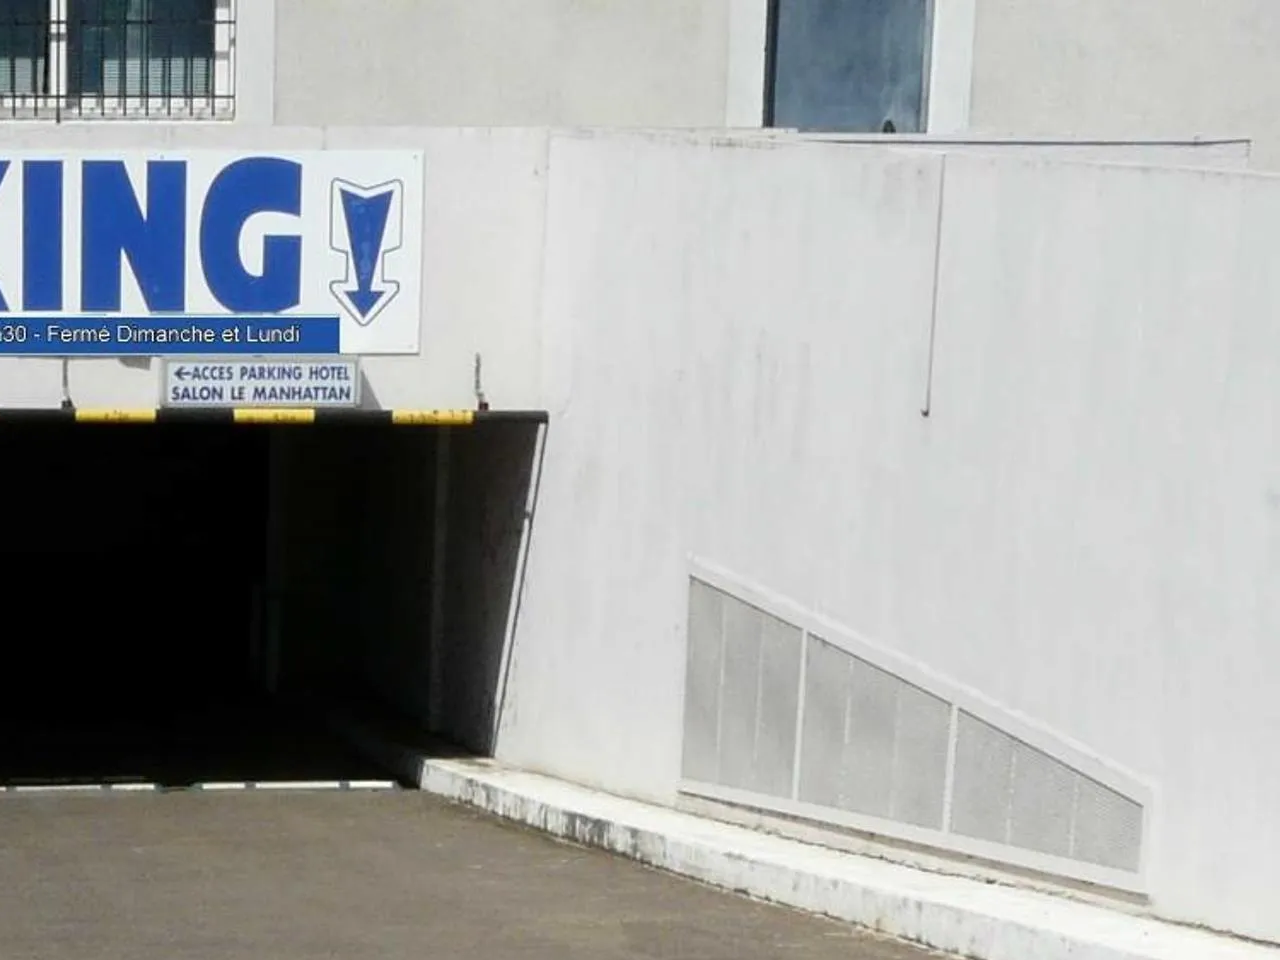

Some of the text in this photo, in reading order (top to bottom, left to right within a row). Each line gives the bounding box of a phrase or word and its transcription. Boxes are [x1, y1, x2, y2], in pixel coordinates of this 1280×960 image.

[192, 366, 350, 380] ACCES PARKING HOTEL
[172, 386, 351, 401] SALON LE MANHATTAN
